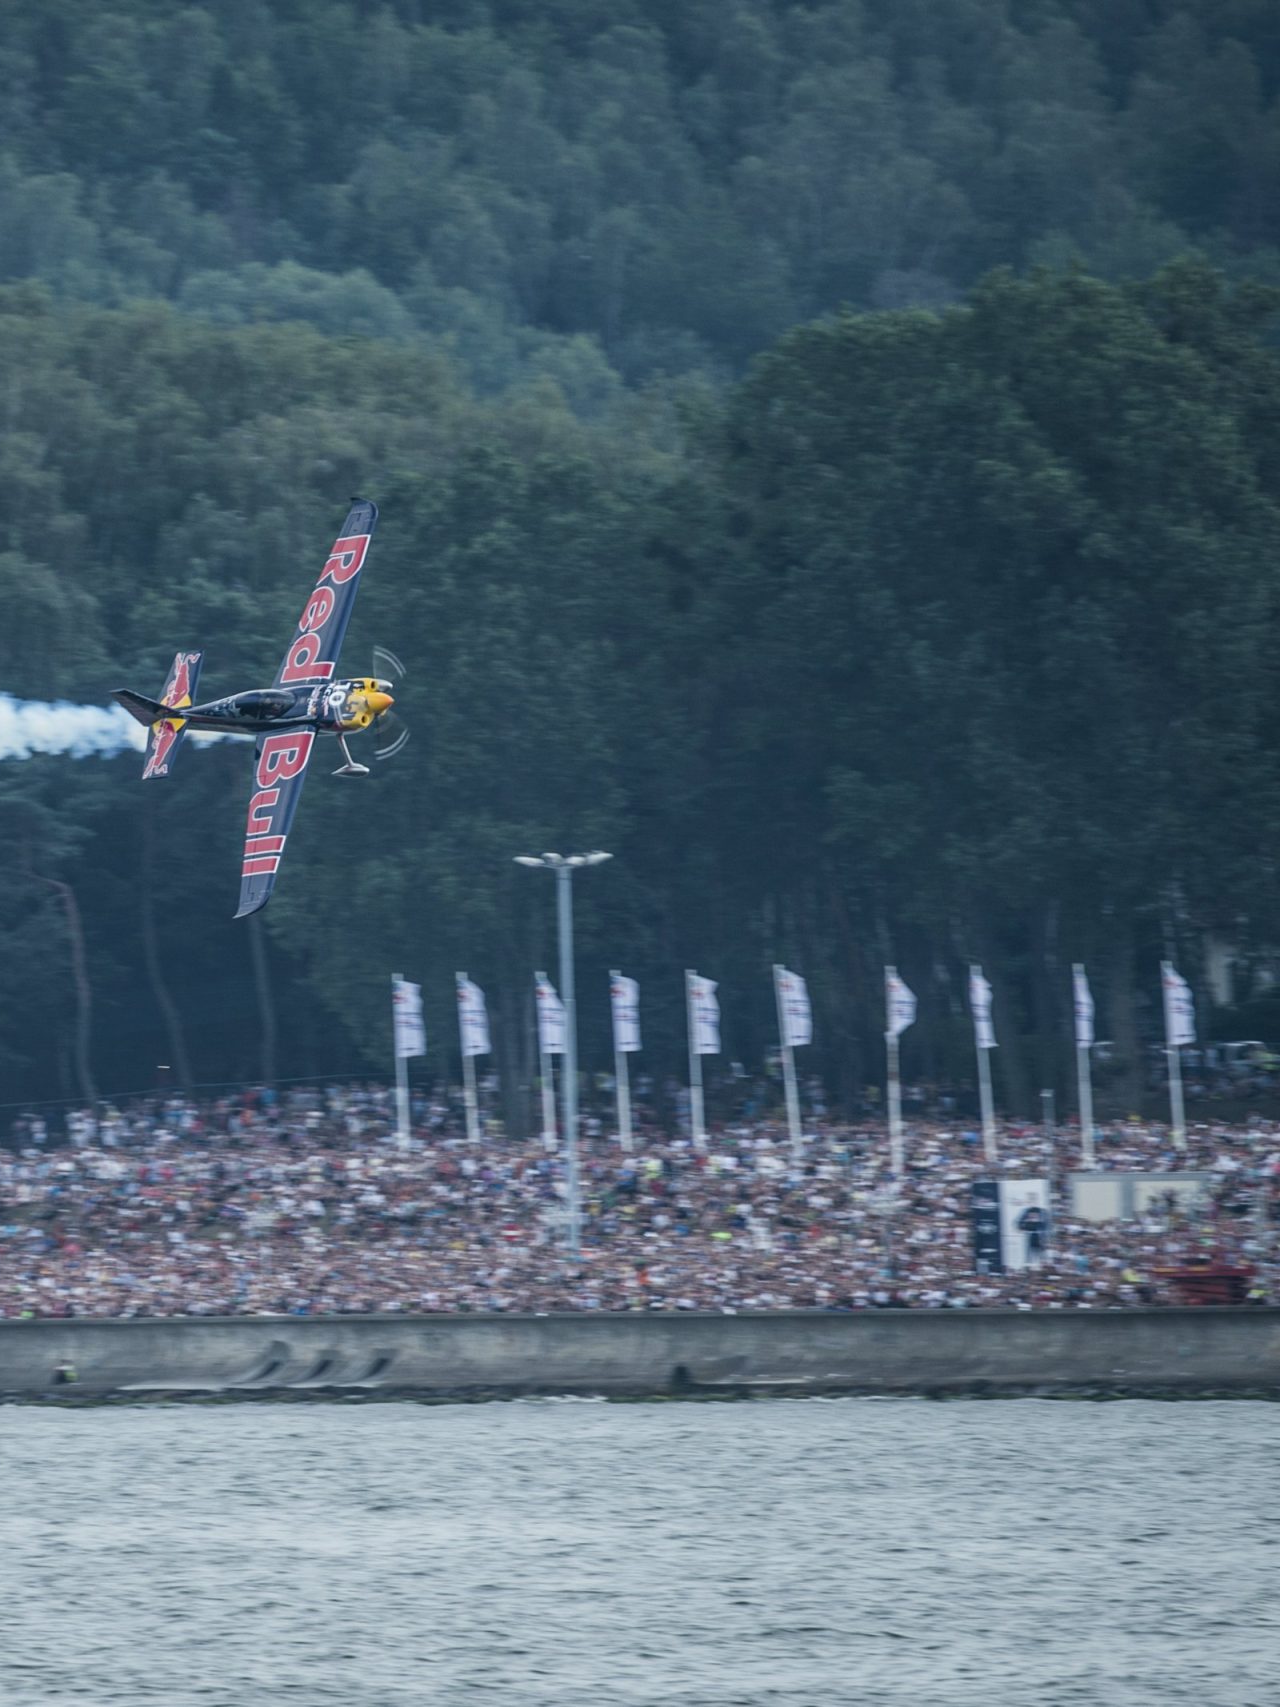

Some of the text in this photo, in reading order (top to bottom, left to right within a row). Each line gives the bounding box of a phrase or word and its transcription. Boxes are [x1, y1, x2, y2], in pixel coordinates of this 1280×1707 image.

[241, 534, 372, 878] Red Bull
[328, 682, 351, 706] 10
